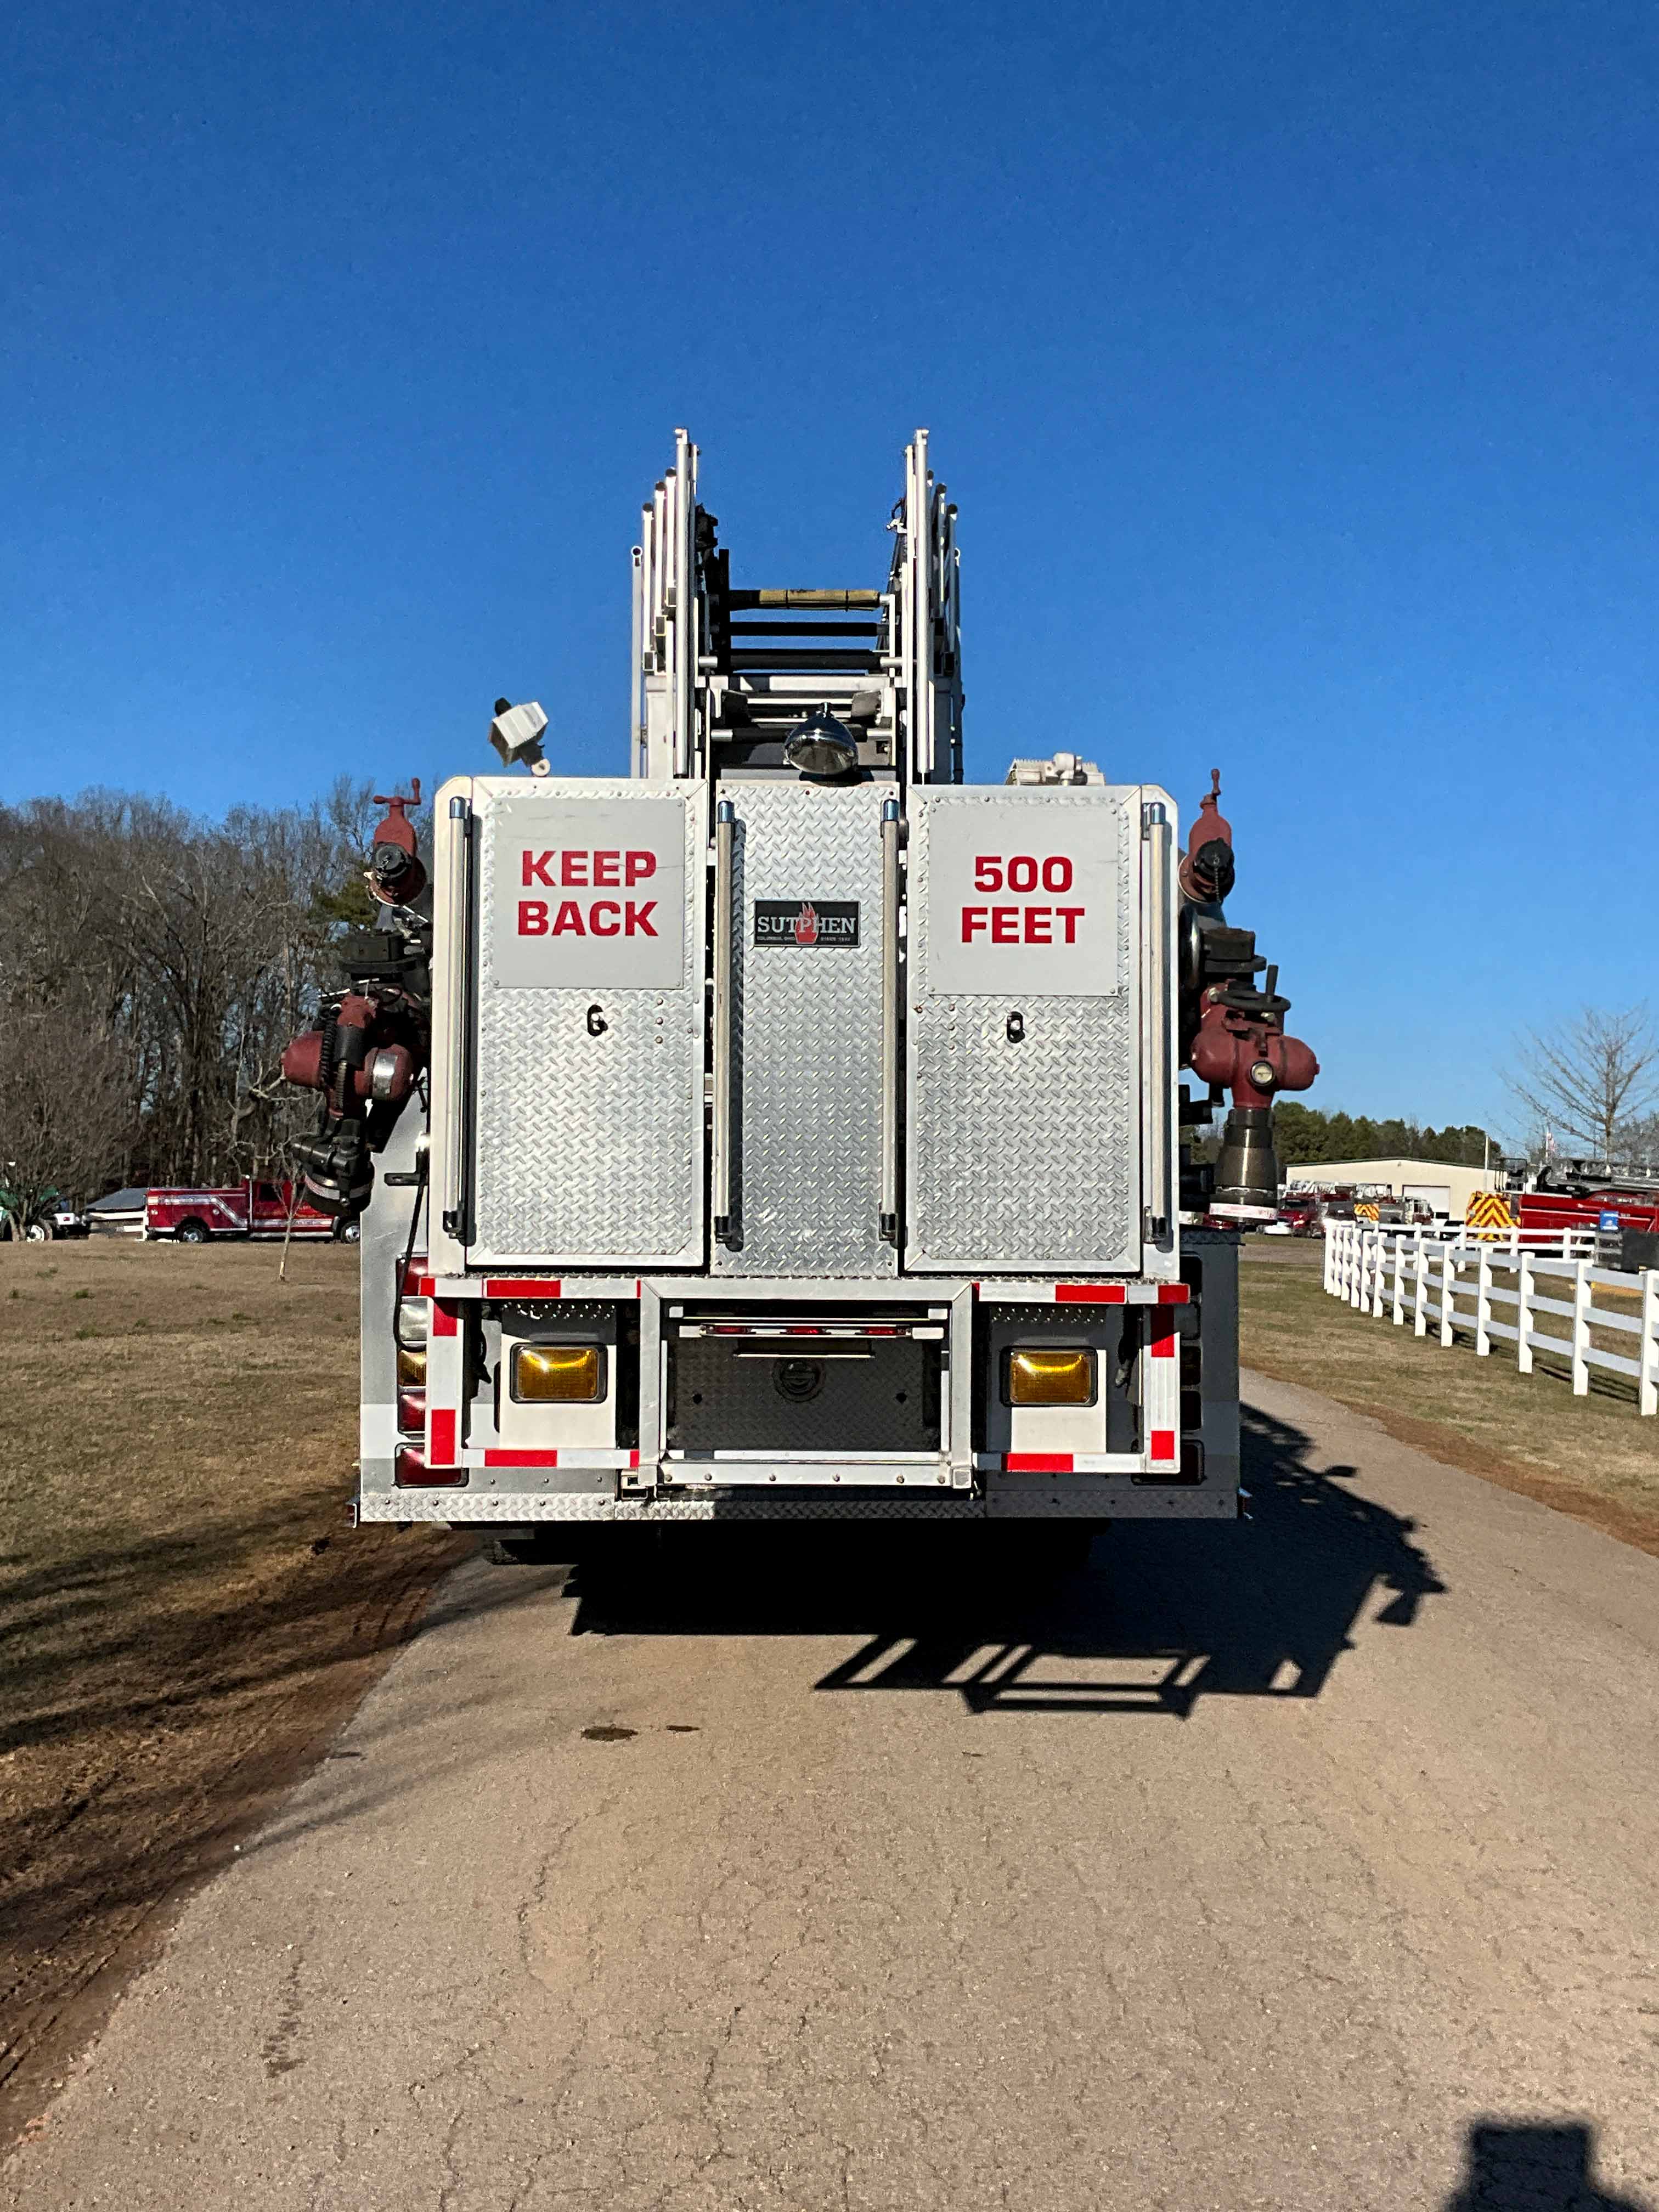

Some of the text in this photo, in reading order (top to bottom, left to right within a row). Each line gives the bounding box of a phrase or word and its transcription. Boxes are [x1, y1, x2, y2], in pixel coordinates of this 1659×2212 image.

[522, 851, 656, 887] KEEP
[974, 856, 1073, 893] 500
[518, 900, 658, 936] BACK
[757, 916, 856, 933] SUTPHEN
[962, 906, 1085, 944] FEET
